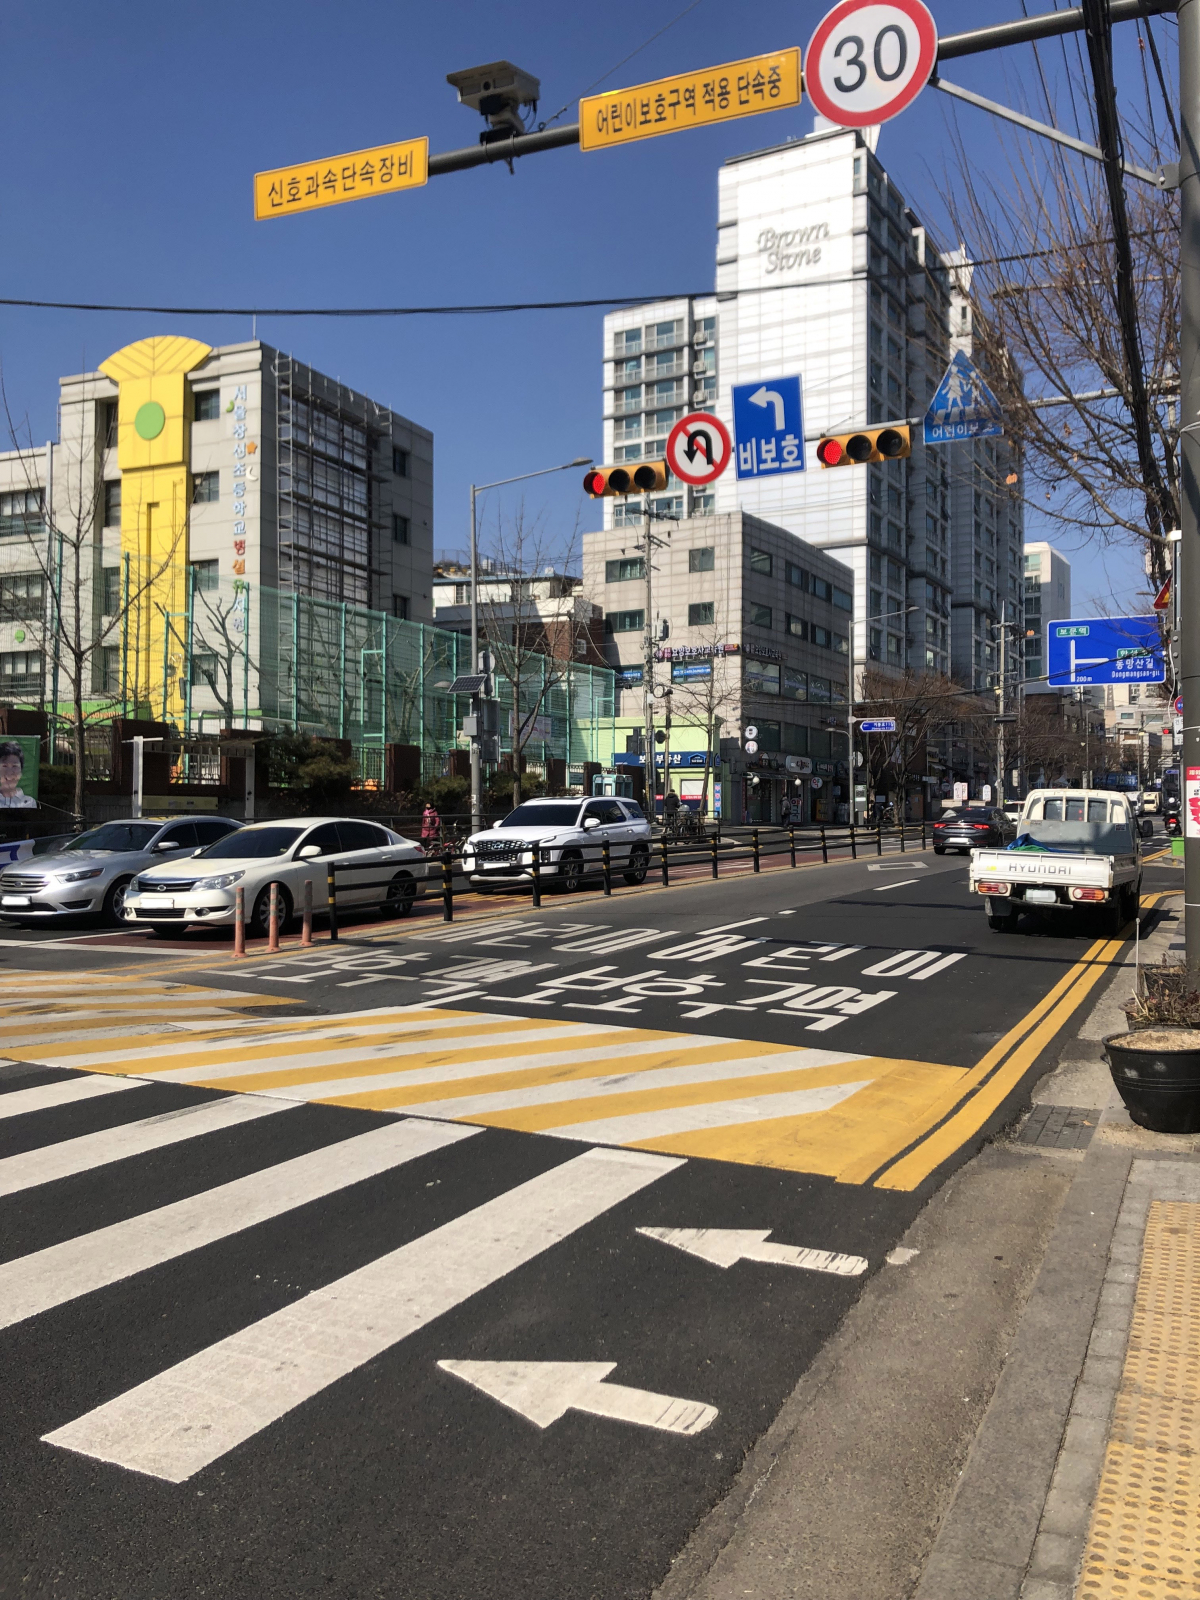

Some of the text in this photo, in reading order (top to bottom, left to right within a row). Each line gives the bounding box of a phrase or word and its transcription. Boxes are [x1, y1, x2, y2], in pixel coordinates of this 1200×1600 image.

[833, 24, 908, 93] 30
[596, 66, 782, 136] 어린이보호구역 적용 단속중
[267, 149, 414, 208] 신호과속단속장비
[757, 222, 830, 253] Brown
[765, 246, 822, 274] Stone
[739, 433, 802, 474] 비보호
[1059, 627, 1087, 636] 보문역
[1115, 657, 1154, 670] 동망산길
[638, 754, 682, 764] 보부산
[1008, 863, 1072, 875] HYUNDAI
[408, 919, 682, 955] 어린이
[199, 949, 560, 996] 보호구역
[646, 934, 969, 981] 어린이
[483, 965, 899, 1032] 보호구역
